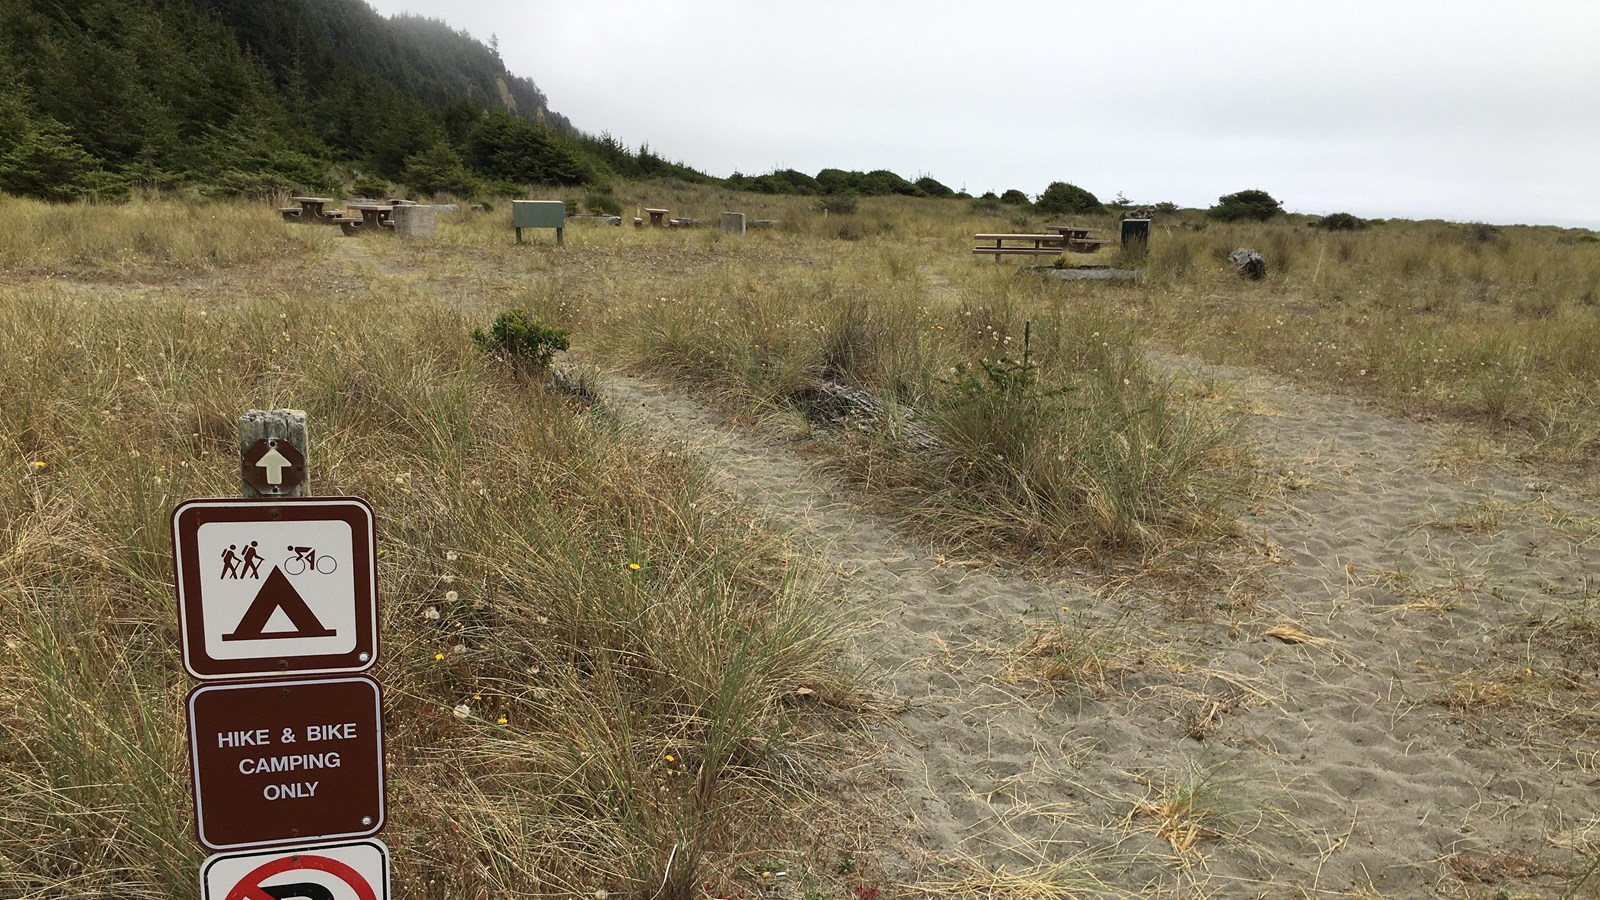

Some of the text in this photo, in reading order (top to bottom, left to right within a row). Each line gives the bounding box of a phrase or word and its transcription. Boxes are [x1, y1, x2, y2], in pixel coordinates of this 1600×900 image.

[217, 723, 357, 748] HIKE & BIKE
[238, 752, 341, 775] CAMPING
[263, 781, 319, 801] ONLY
